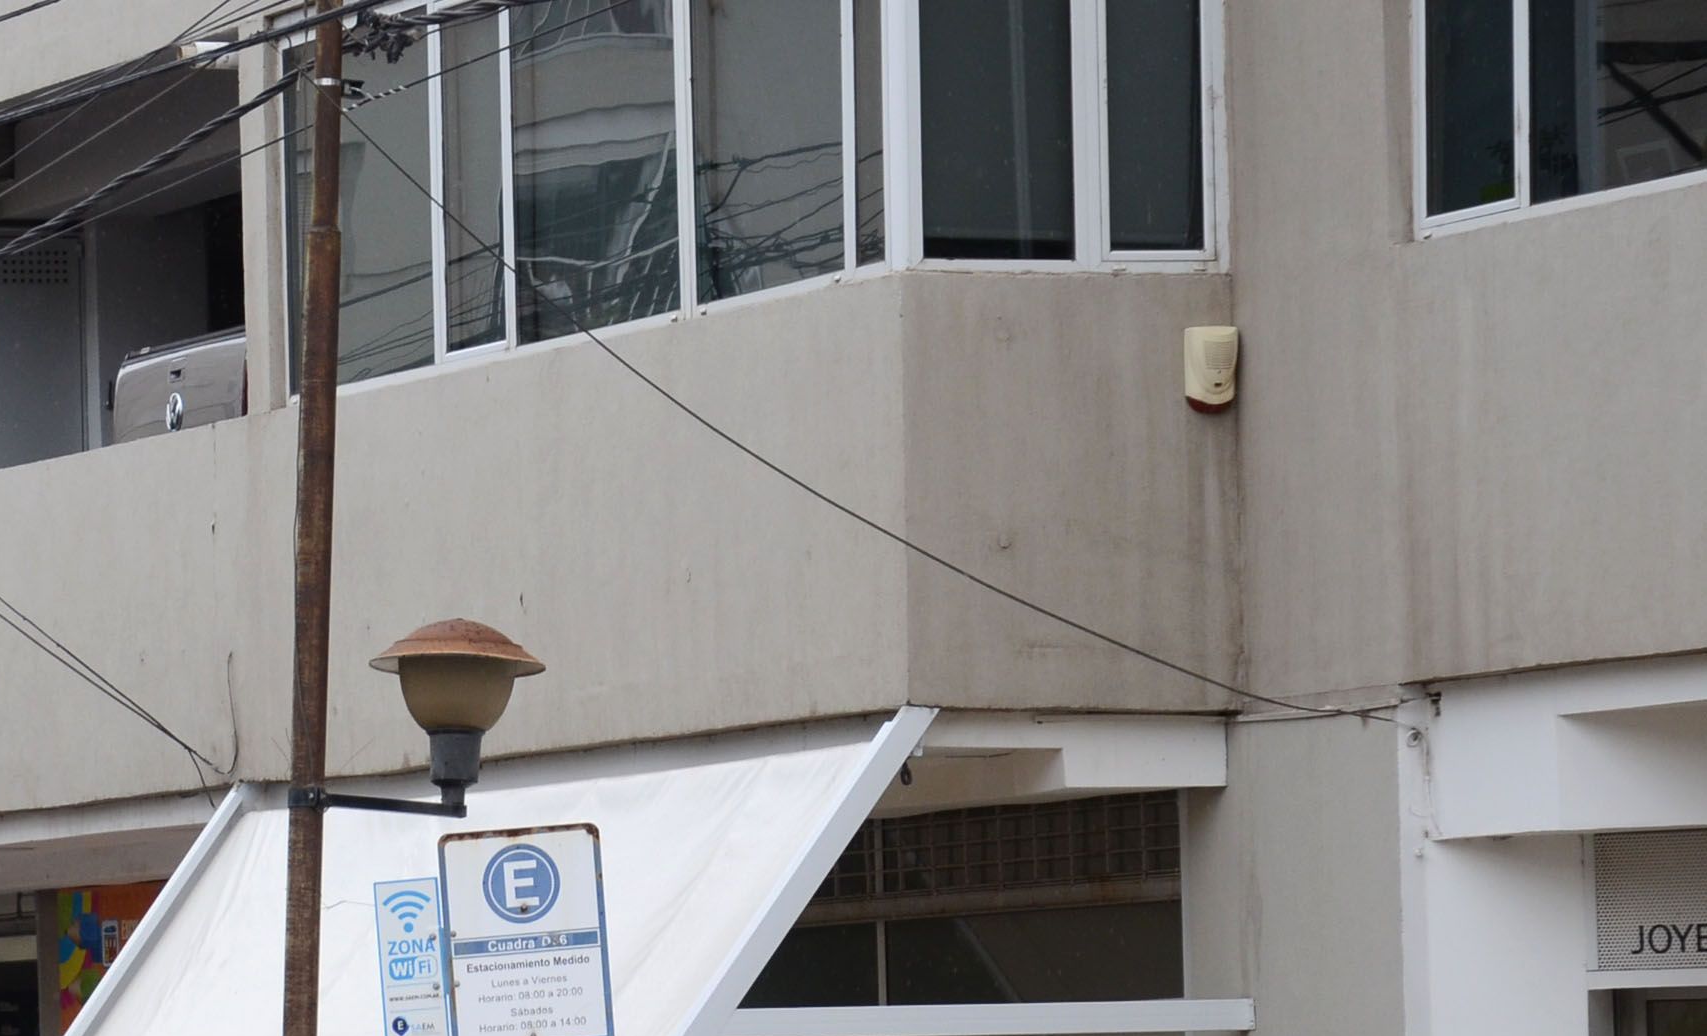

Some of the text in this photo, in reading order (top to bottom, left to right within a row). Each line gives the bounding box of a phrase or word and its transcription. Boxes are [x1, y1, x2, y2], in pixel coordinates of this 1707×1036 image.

[503, 859, 540, 909] E
[388, 938, 436, 956] ZONA
[488, 936, 536, 951] Cuadra
[466, 955, 590, 974] Estacionamiento Medido
[491, 979, 520, 988] Lunes
[531, 975, 568, 985] Viernes
[478, 994, 515, 1004] Horario:
[518, 990, 546, 999] 08:00
[557, 987, 583, 997] 20:00
[510, 1006, 554, 1017] Sábados
[479, 1023, 518, 1033] Horario:
[520, 1020, 548, 1030] 08:00
[560, 1016, 587, 1026] 14:00
